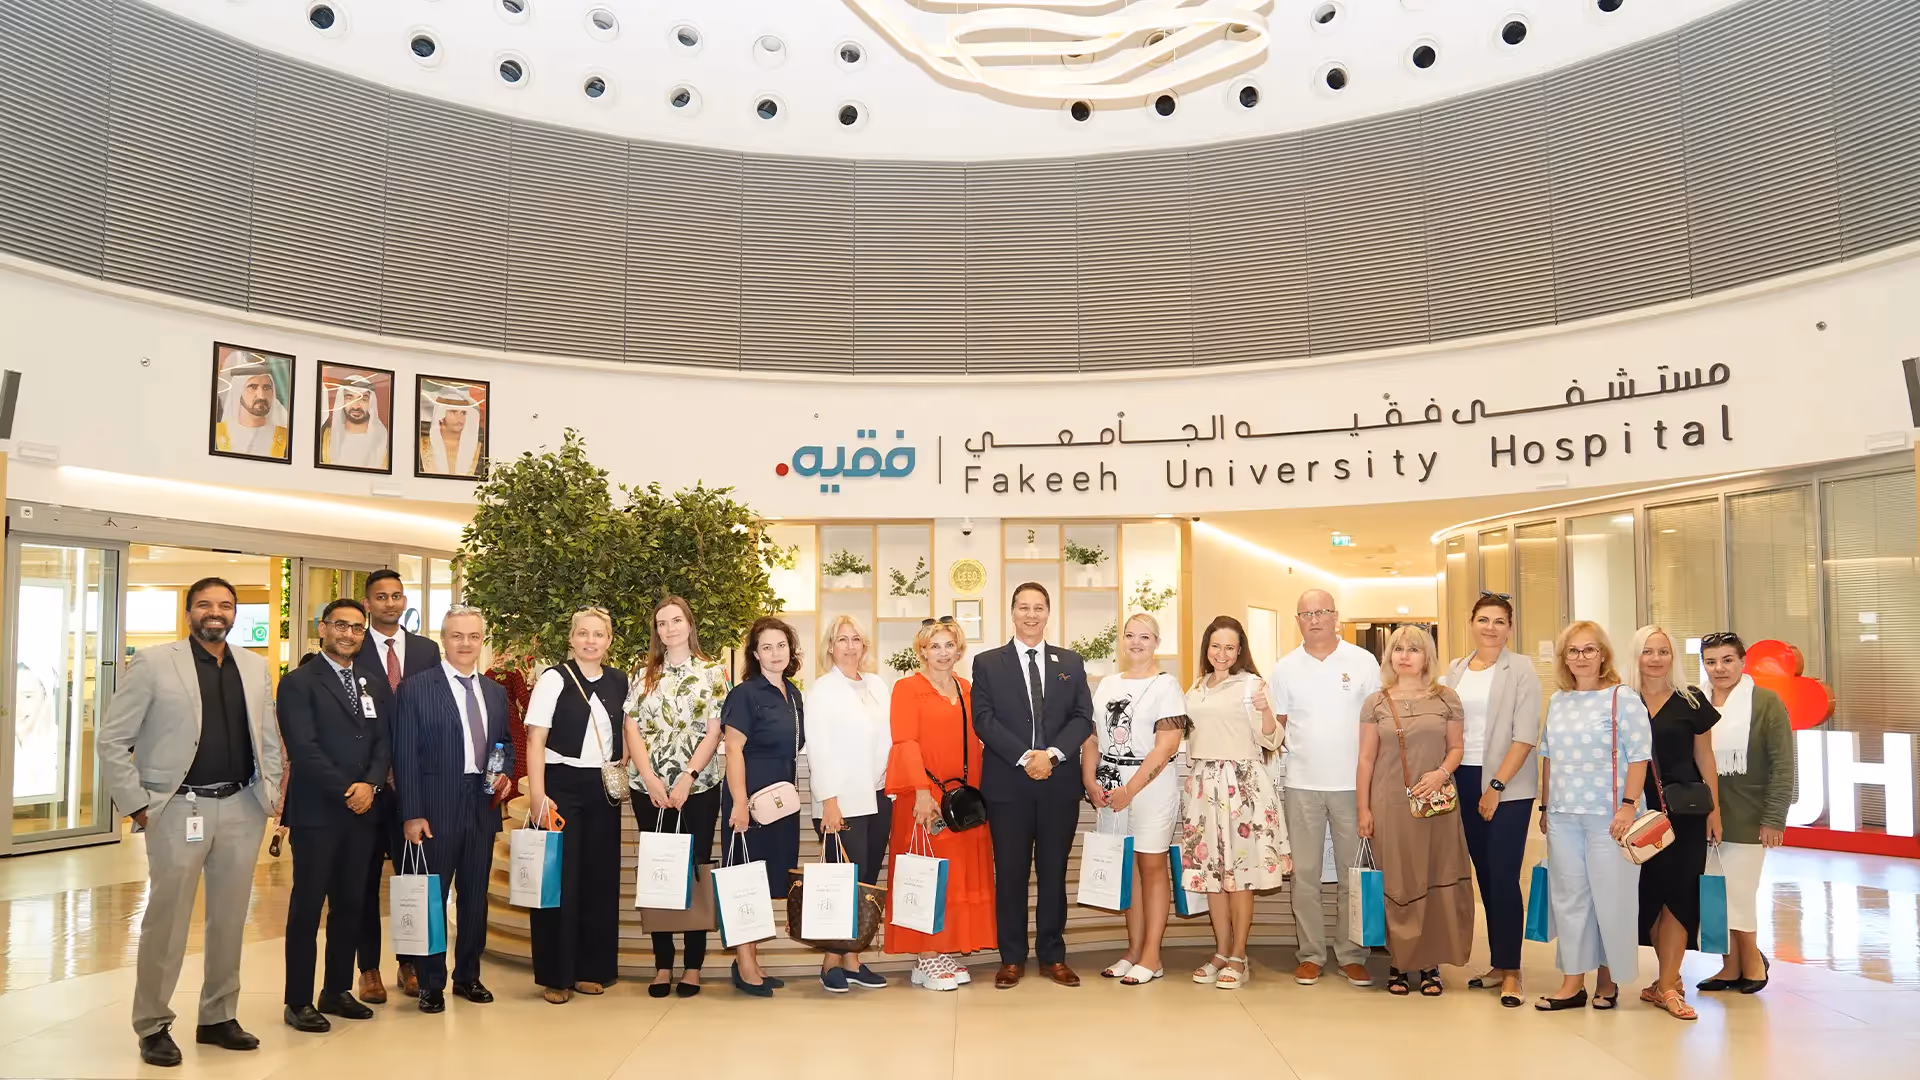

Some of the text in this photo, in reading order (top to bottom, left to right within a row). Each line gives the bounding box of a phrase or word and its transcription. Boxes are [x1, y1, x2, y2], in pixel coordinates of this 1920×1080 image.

[964, 362, 1731, 459] مستشفى فقيه الجامعي
[965, 404, 1734, 494] Fakeeh University Hospital
